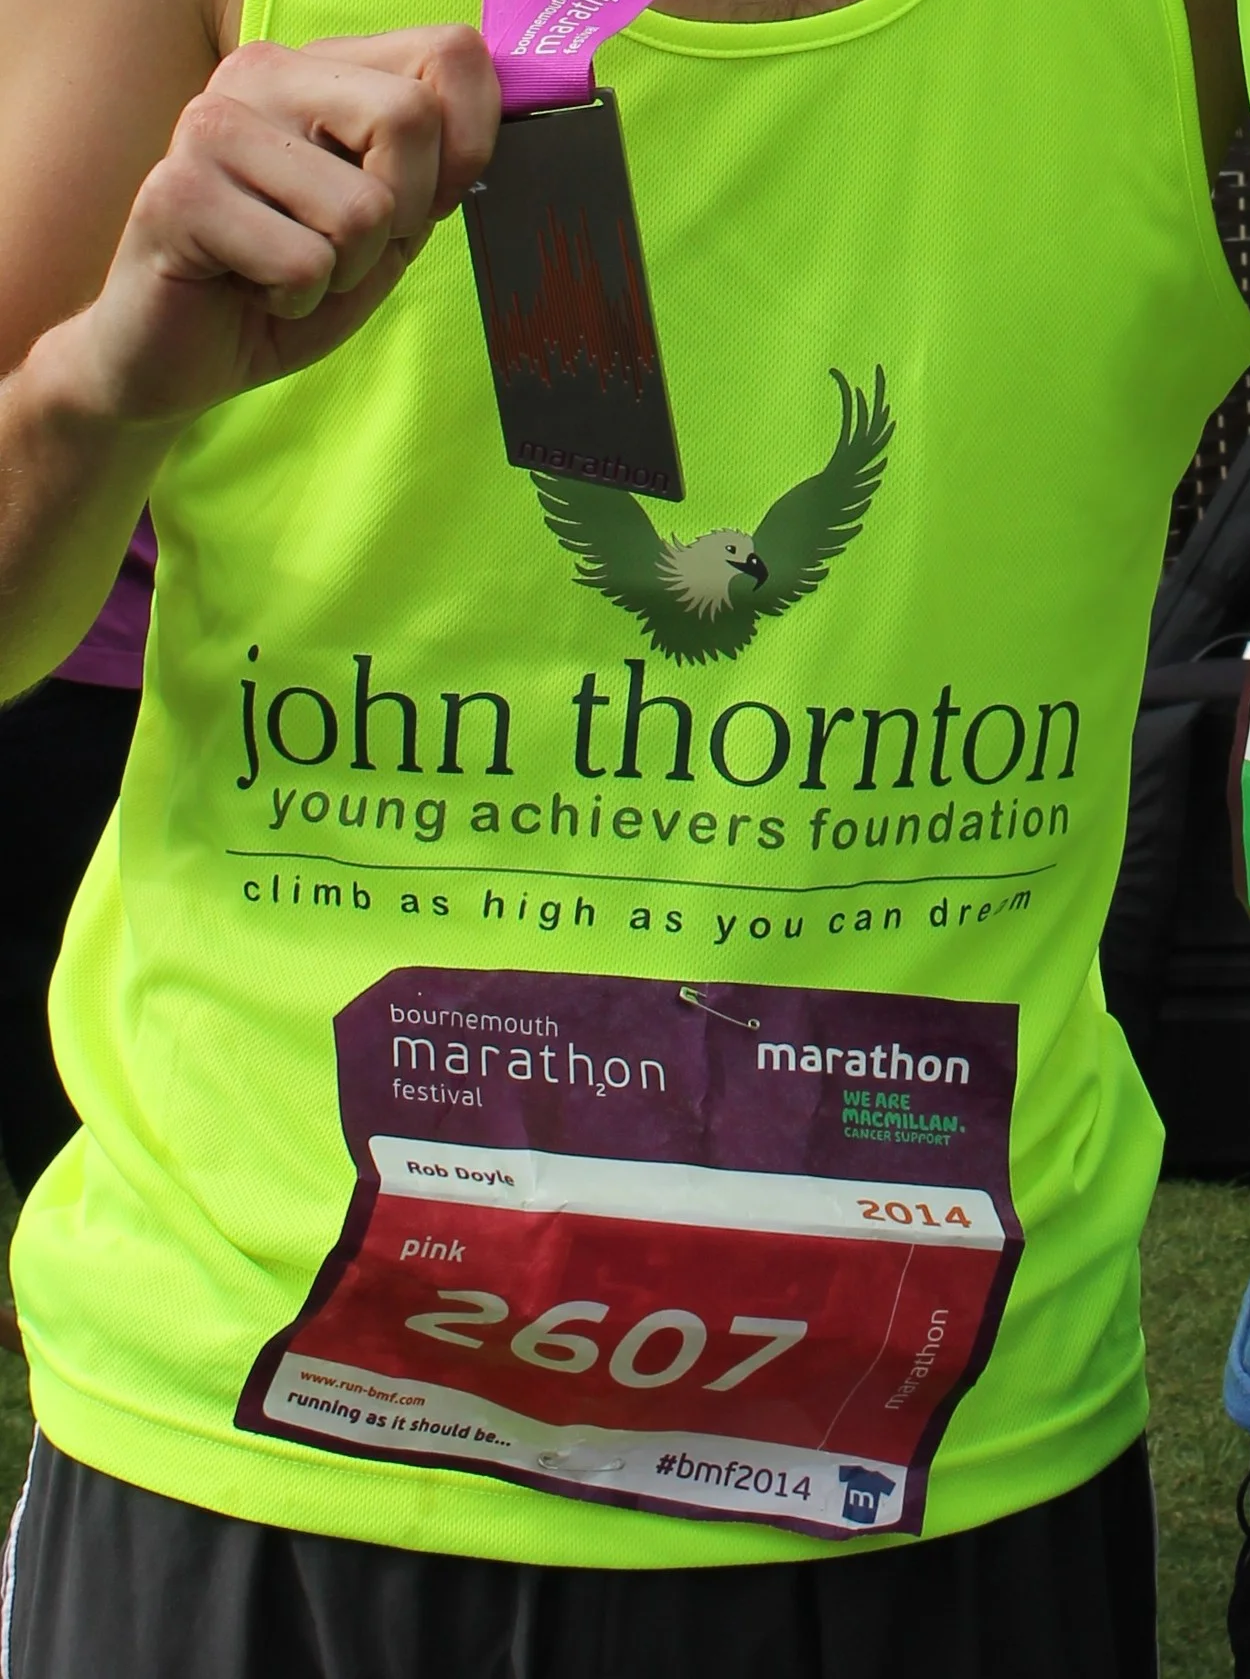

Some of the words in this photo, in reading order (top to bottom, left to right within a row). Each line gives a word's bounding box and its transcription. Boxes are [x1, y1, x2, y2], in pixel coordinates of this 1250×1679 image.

[563, 25, 601, 55] festival
[518, 441, 671, 494] marathon
[236, 644, 516, 790] john
[571, 659, 1082, 791] thornton
[268, 786, 449, 843] young
[469, 793, 787, 852] achievers
[809, 798, 1071, 851] foundation
[243, 873, 372, 911] climb
[400, 891, 450, 917] as
[482, 889, 596, 931] high
[629, 906, 684, 934] as
[713, 913, 803, 946] you
[828, 905, 902, 934] can
[389, 1003, 559, 1038] bournemouth
[757, 1042, 970, 1084] marathon
[392, 1078, 483, 1107] festival
[843, 1089, 871, 1108] WE
[875, 1092, 911, 1111] ARE
[844, 1127, 892, 1142] CANCER
[895, 1131, 952, 1146] SUPPORT
[406, 1160, 449, 1178] Rob
[455, 1166, 515, 1187] Doyle
[856, 1199, 972, 1229] 2014
[399, 1233, 467, 1266] pink
[404, 1288, 809, 1394] 2607
[885, 1308, 949, 1410] marathon
[300, 1370, 425, 1407] www.run-bmf.com
[287, 1390, 361, 1424] running
[365, 1411, 387, 1428] as
[391, 1416, 406, 1431] it
[410, 1417, 470, 1439] should
[474, 1428, 512, 1447] be...
[655, 1452, 812, 1501] #bmf2014
